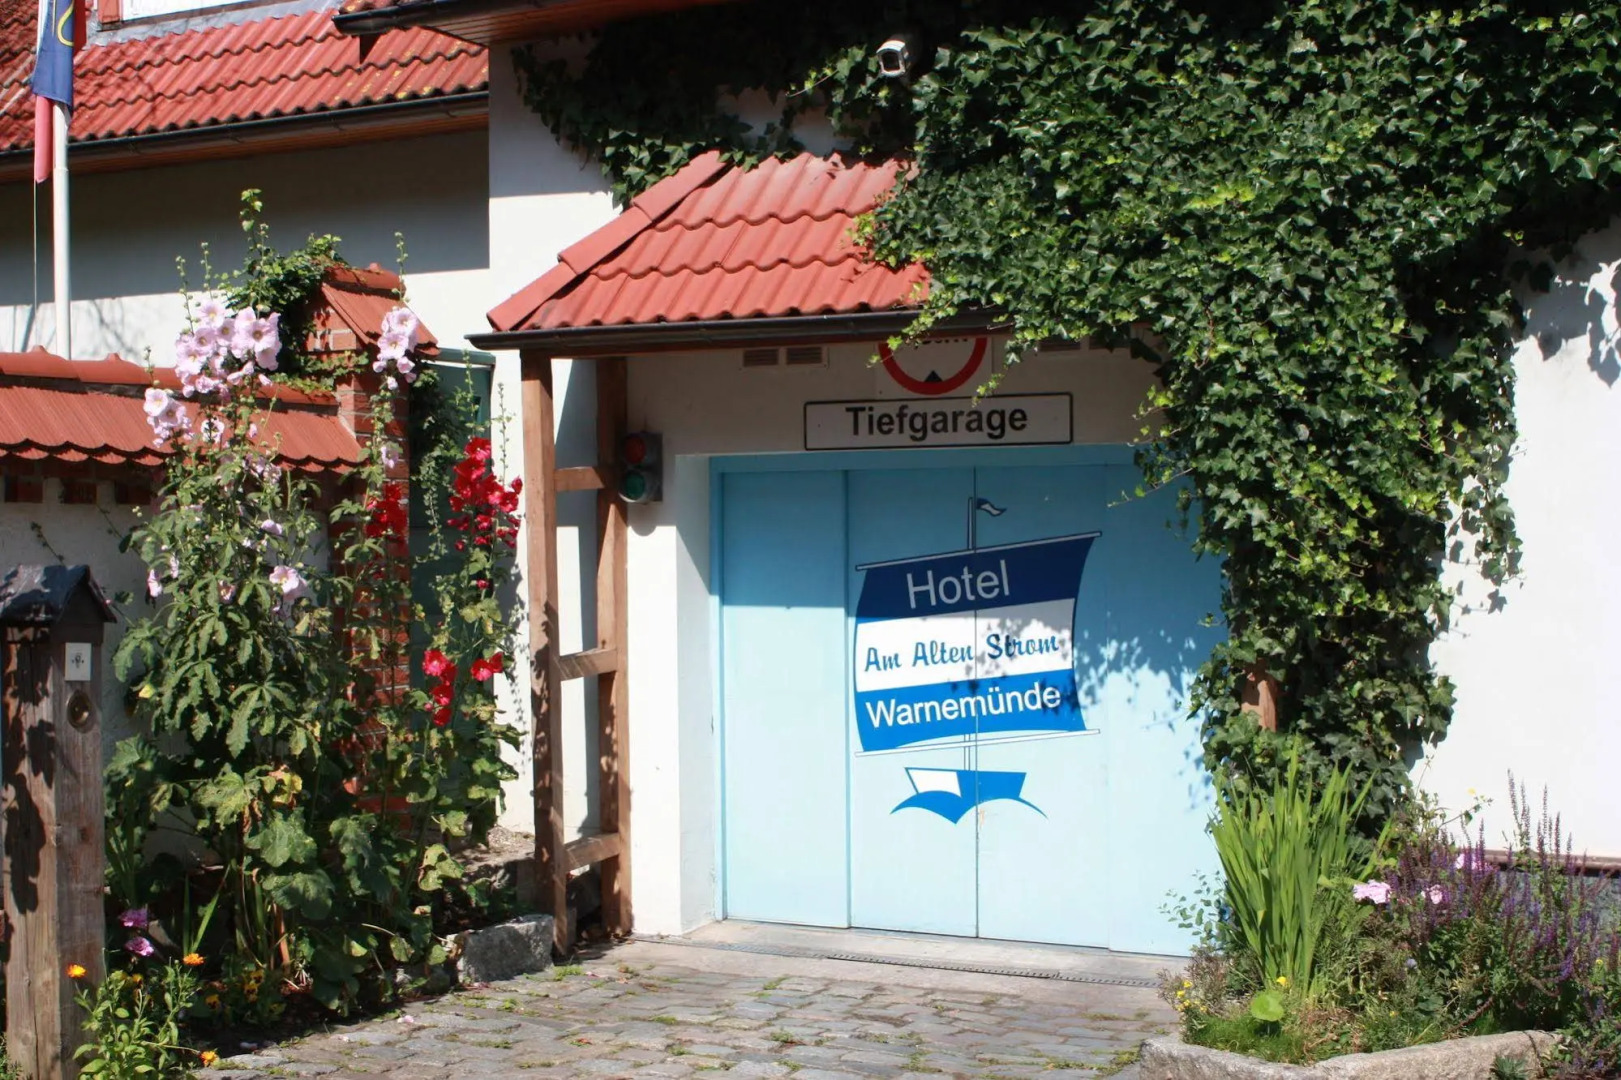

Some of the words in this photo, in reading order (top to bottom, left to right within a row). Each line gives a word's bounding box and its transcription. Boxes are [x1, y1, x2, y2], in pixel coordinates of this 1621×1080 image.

[845, 405, 1028, 442] Tiefgarage
[907, 559, 1010, 609] Hotel
[864, 647, 902, 672] Am
[912, 640, 974, 667] Alten
[986, 633, 1059, 660] Strom
[865, 682, 1062, 728] Warnemünde
